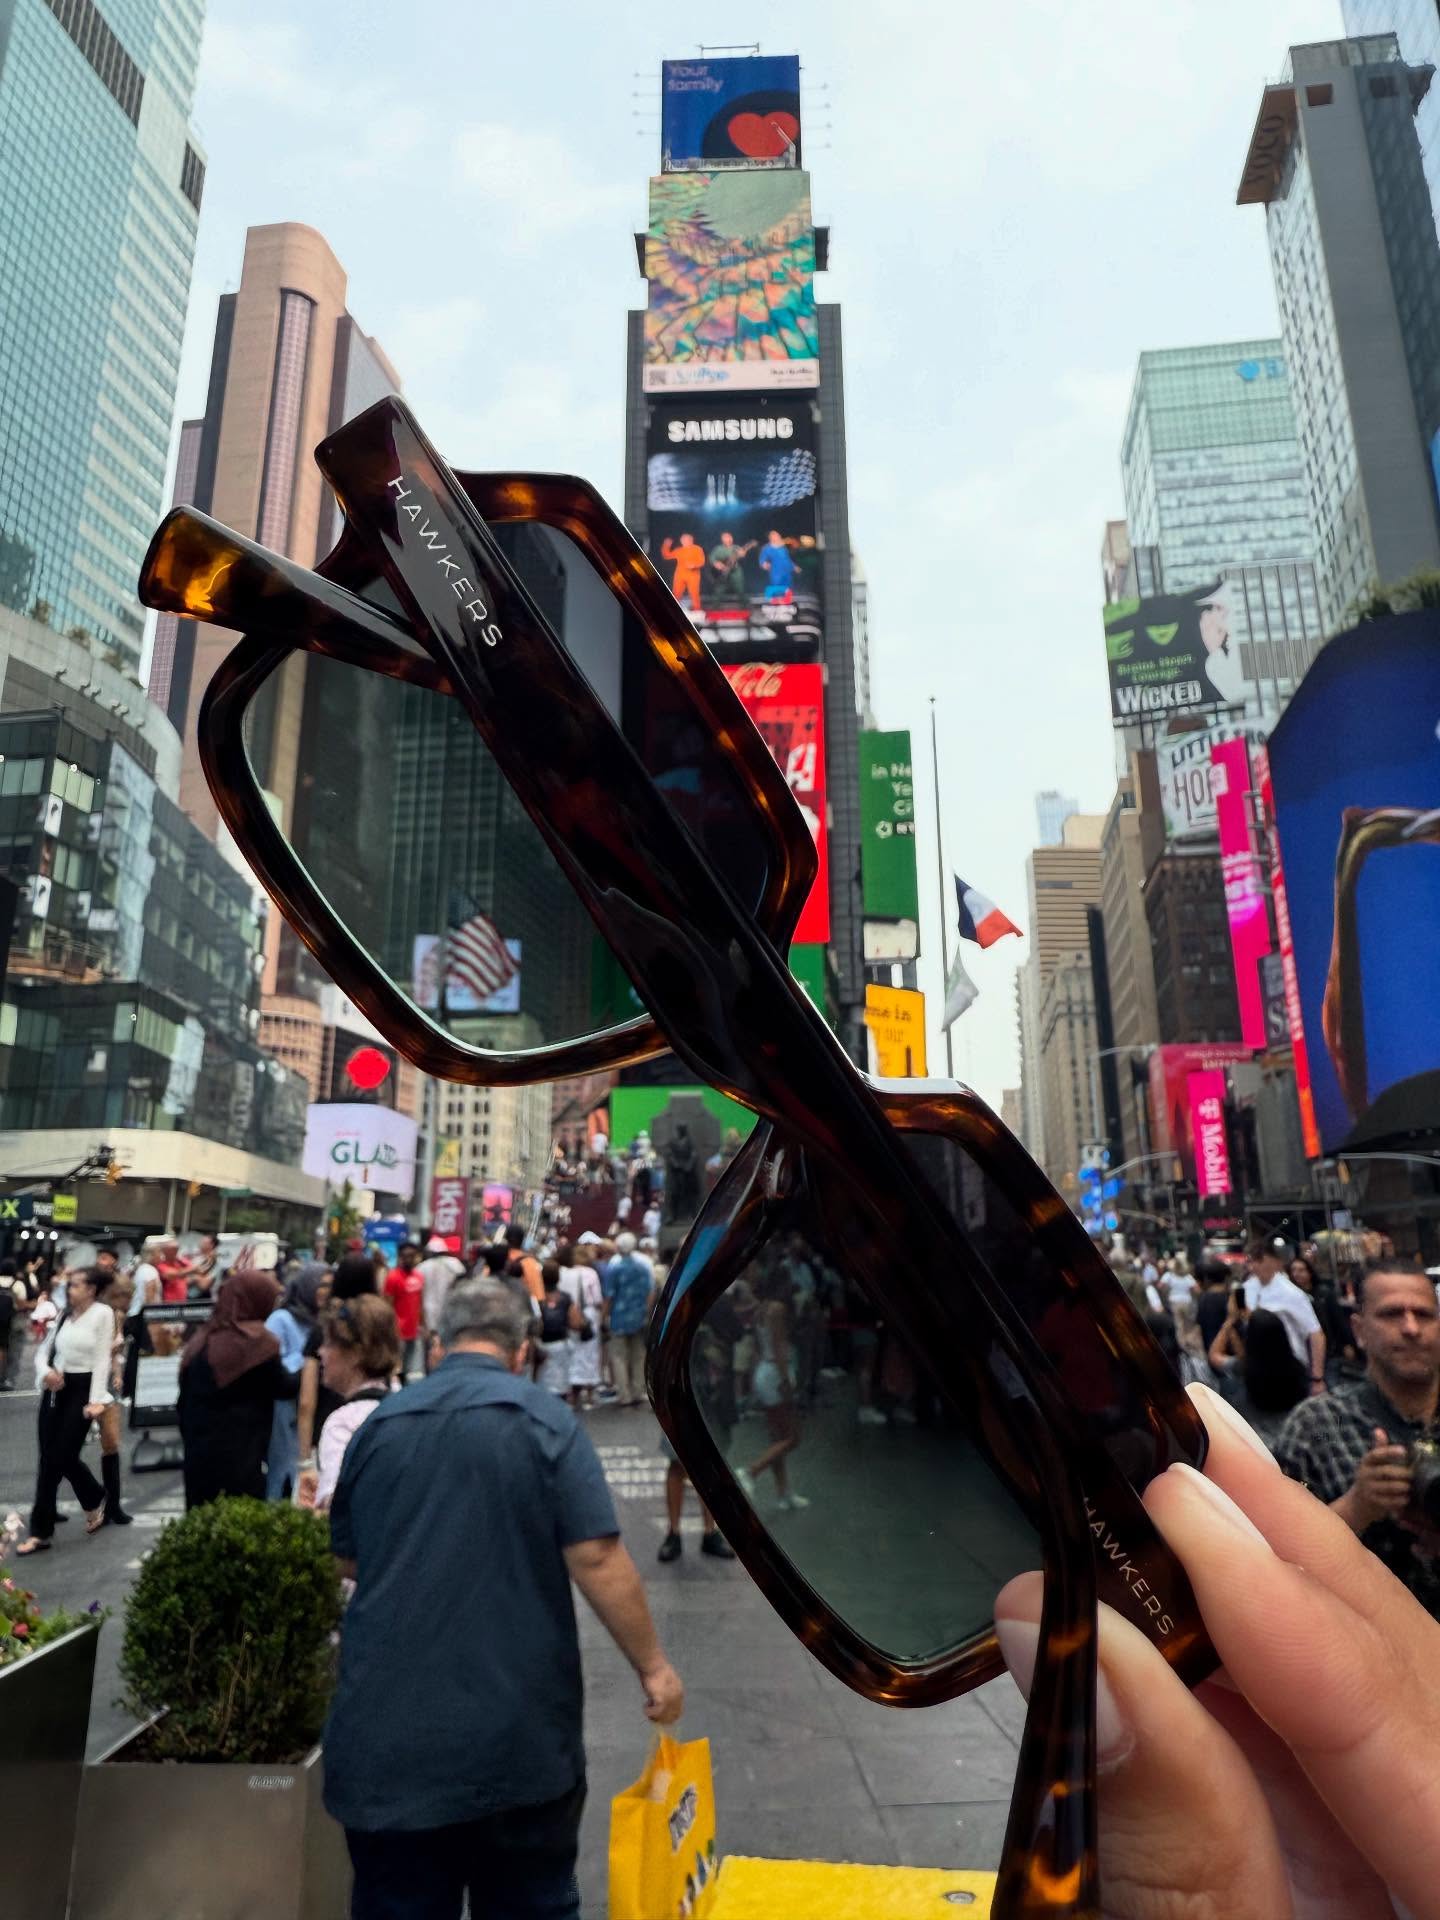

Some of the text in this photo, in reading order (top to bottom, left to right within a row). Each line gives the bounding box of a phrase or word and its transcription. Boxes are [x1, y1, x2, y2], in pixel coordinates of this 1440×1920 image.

[667, 64, 709, 77] Your
[668, 77, 724, 93] family
[667, 417, 794, 443] SAMSUNG
[387, 475, 503, 647] HAWKERS
[1116, 680, 1202, 714] WICKED
[434, 1181, 464, 1233] tkts
